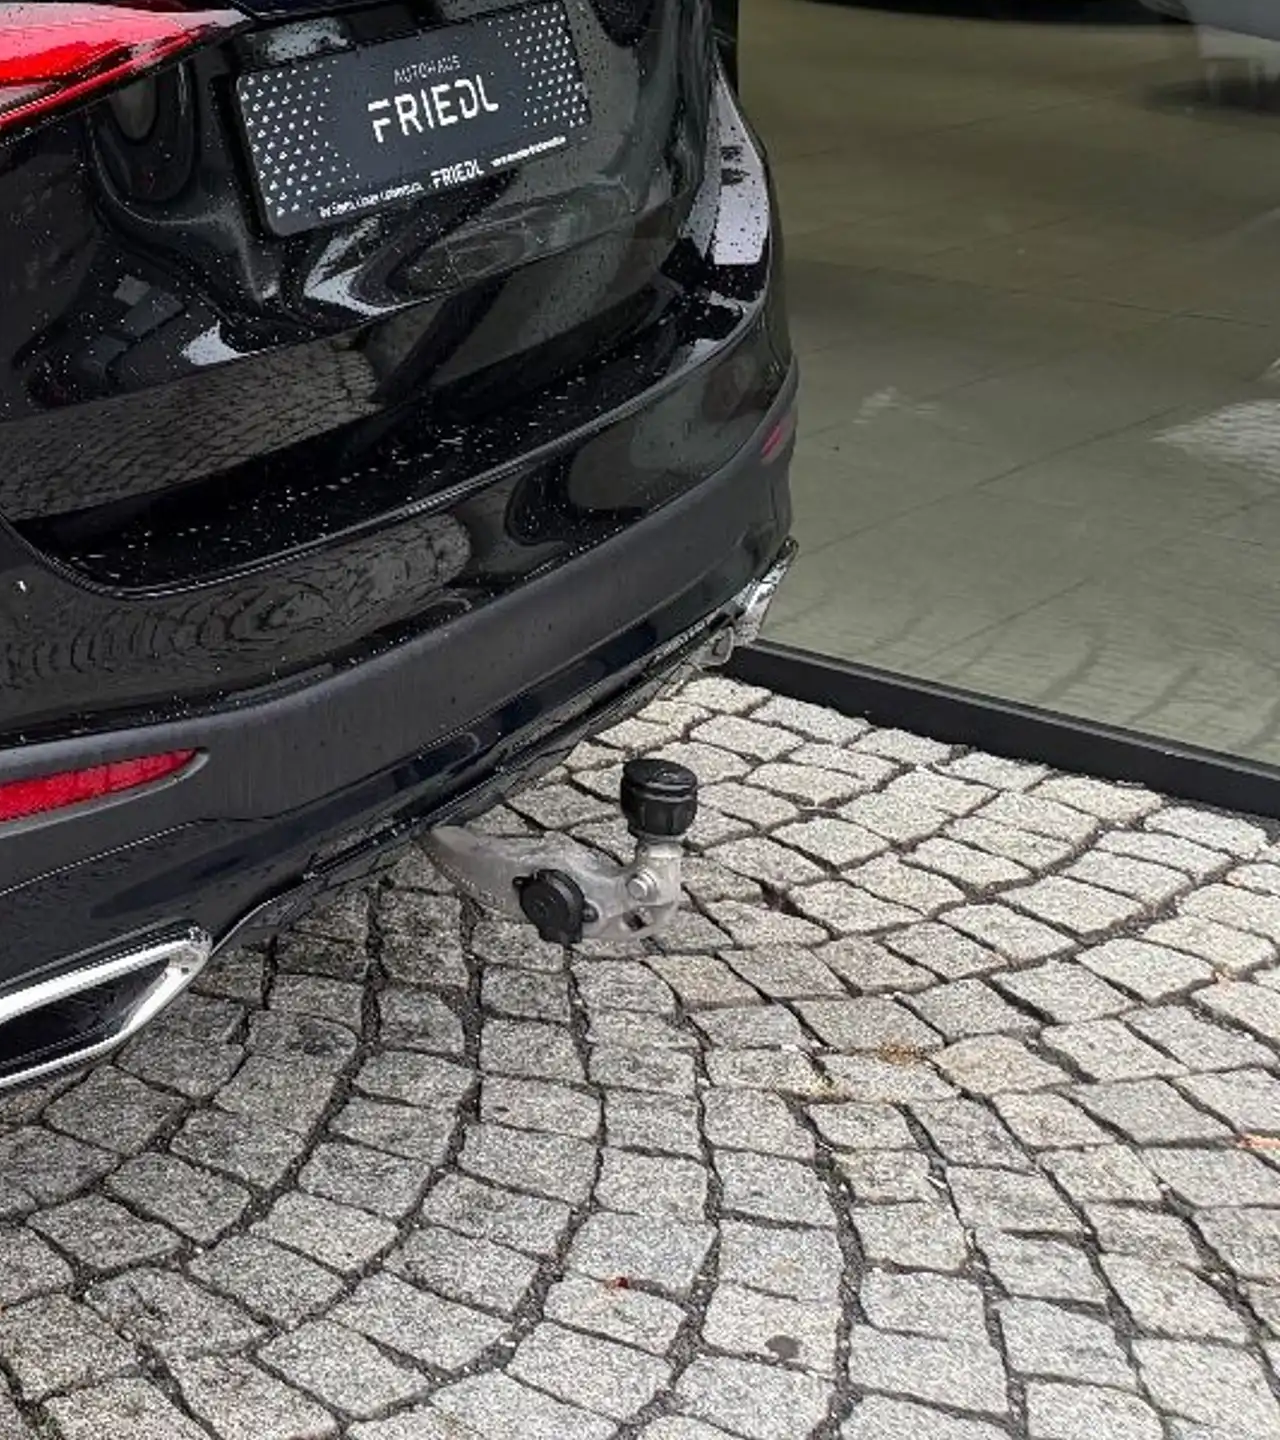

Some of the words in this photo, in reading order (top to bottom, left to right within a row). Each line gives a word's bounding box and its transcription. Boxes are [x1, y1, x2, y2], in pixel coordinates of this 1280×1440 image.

[393, 55, 461, 85] AUTOHAUS
[367, 73, 500, 143] FRIEDL
[430, 159, 485, 189] FRIEDL
